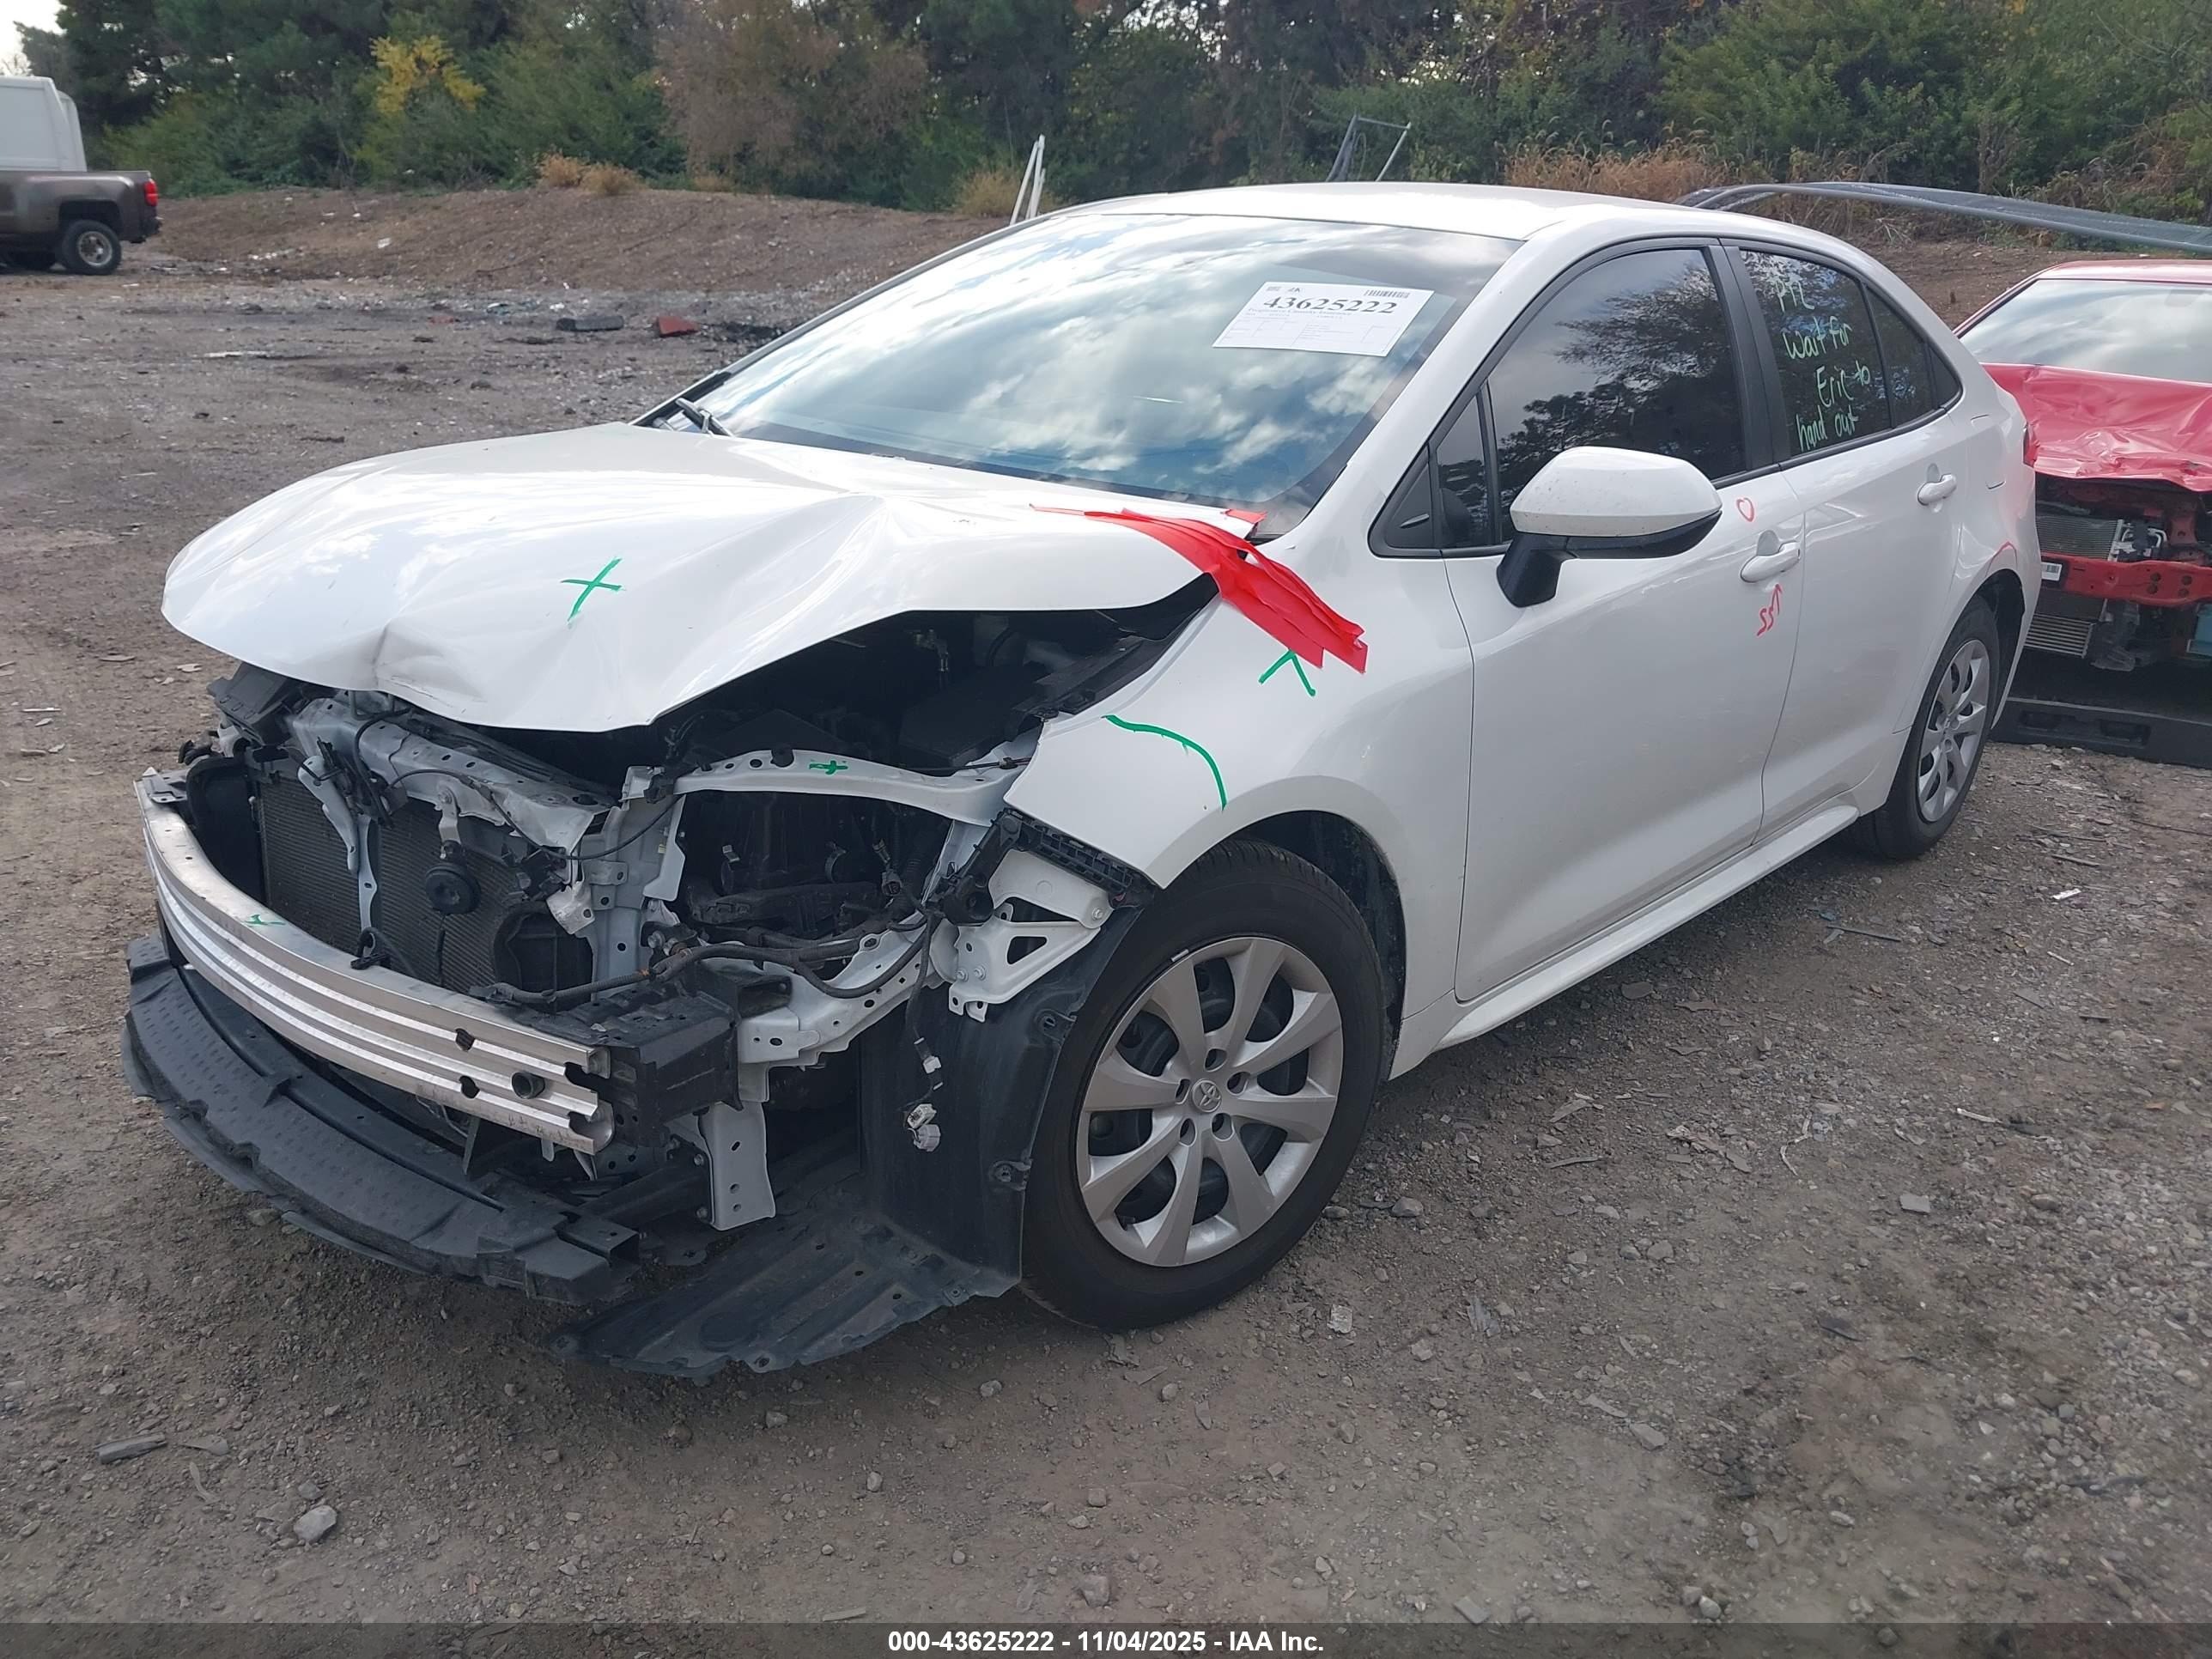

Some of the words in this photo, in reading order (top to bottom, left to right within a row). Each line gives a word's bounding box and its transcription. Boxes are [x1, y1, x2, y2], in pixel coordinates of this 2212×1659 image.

[1264, 297, 1398, 314] 43625222
[1816, 366, 1854, 408] Eric
[1854, 360, 1871, 386] to
[1796, 404, 1828, 453] hand
[1834, 404, 1859, 437] out
